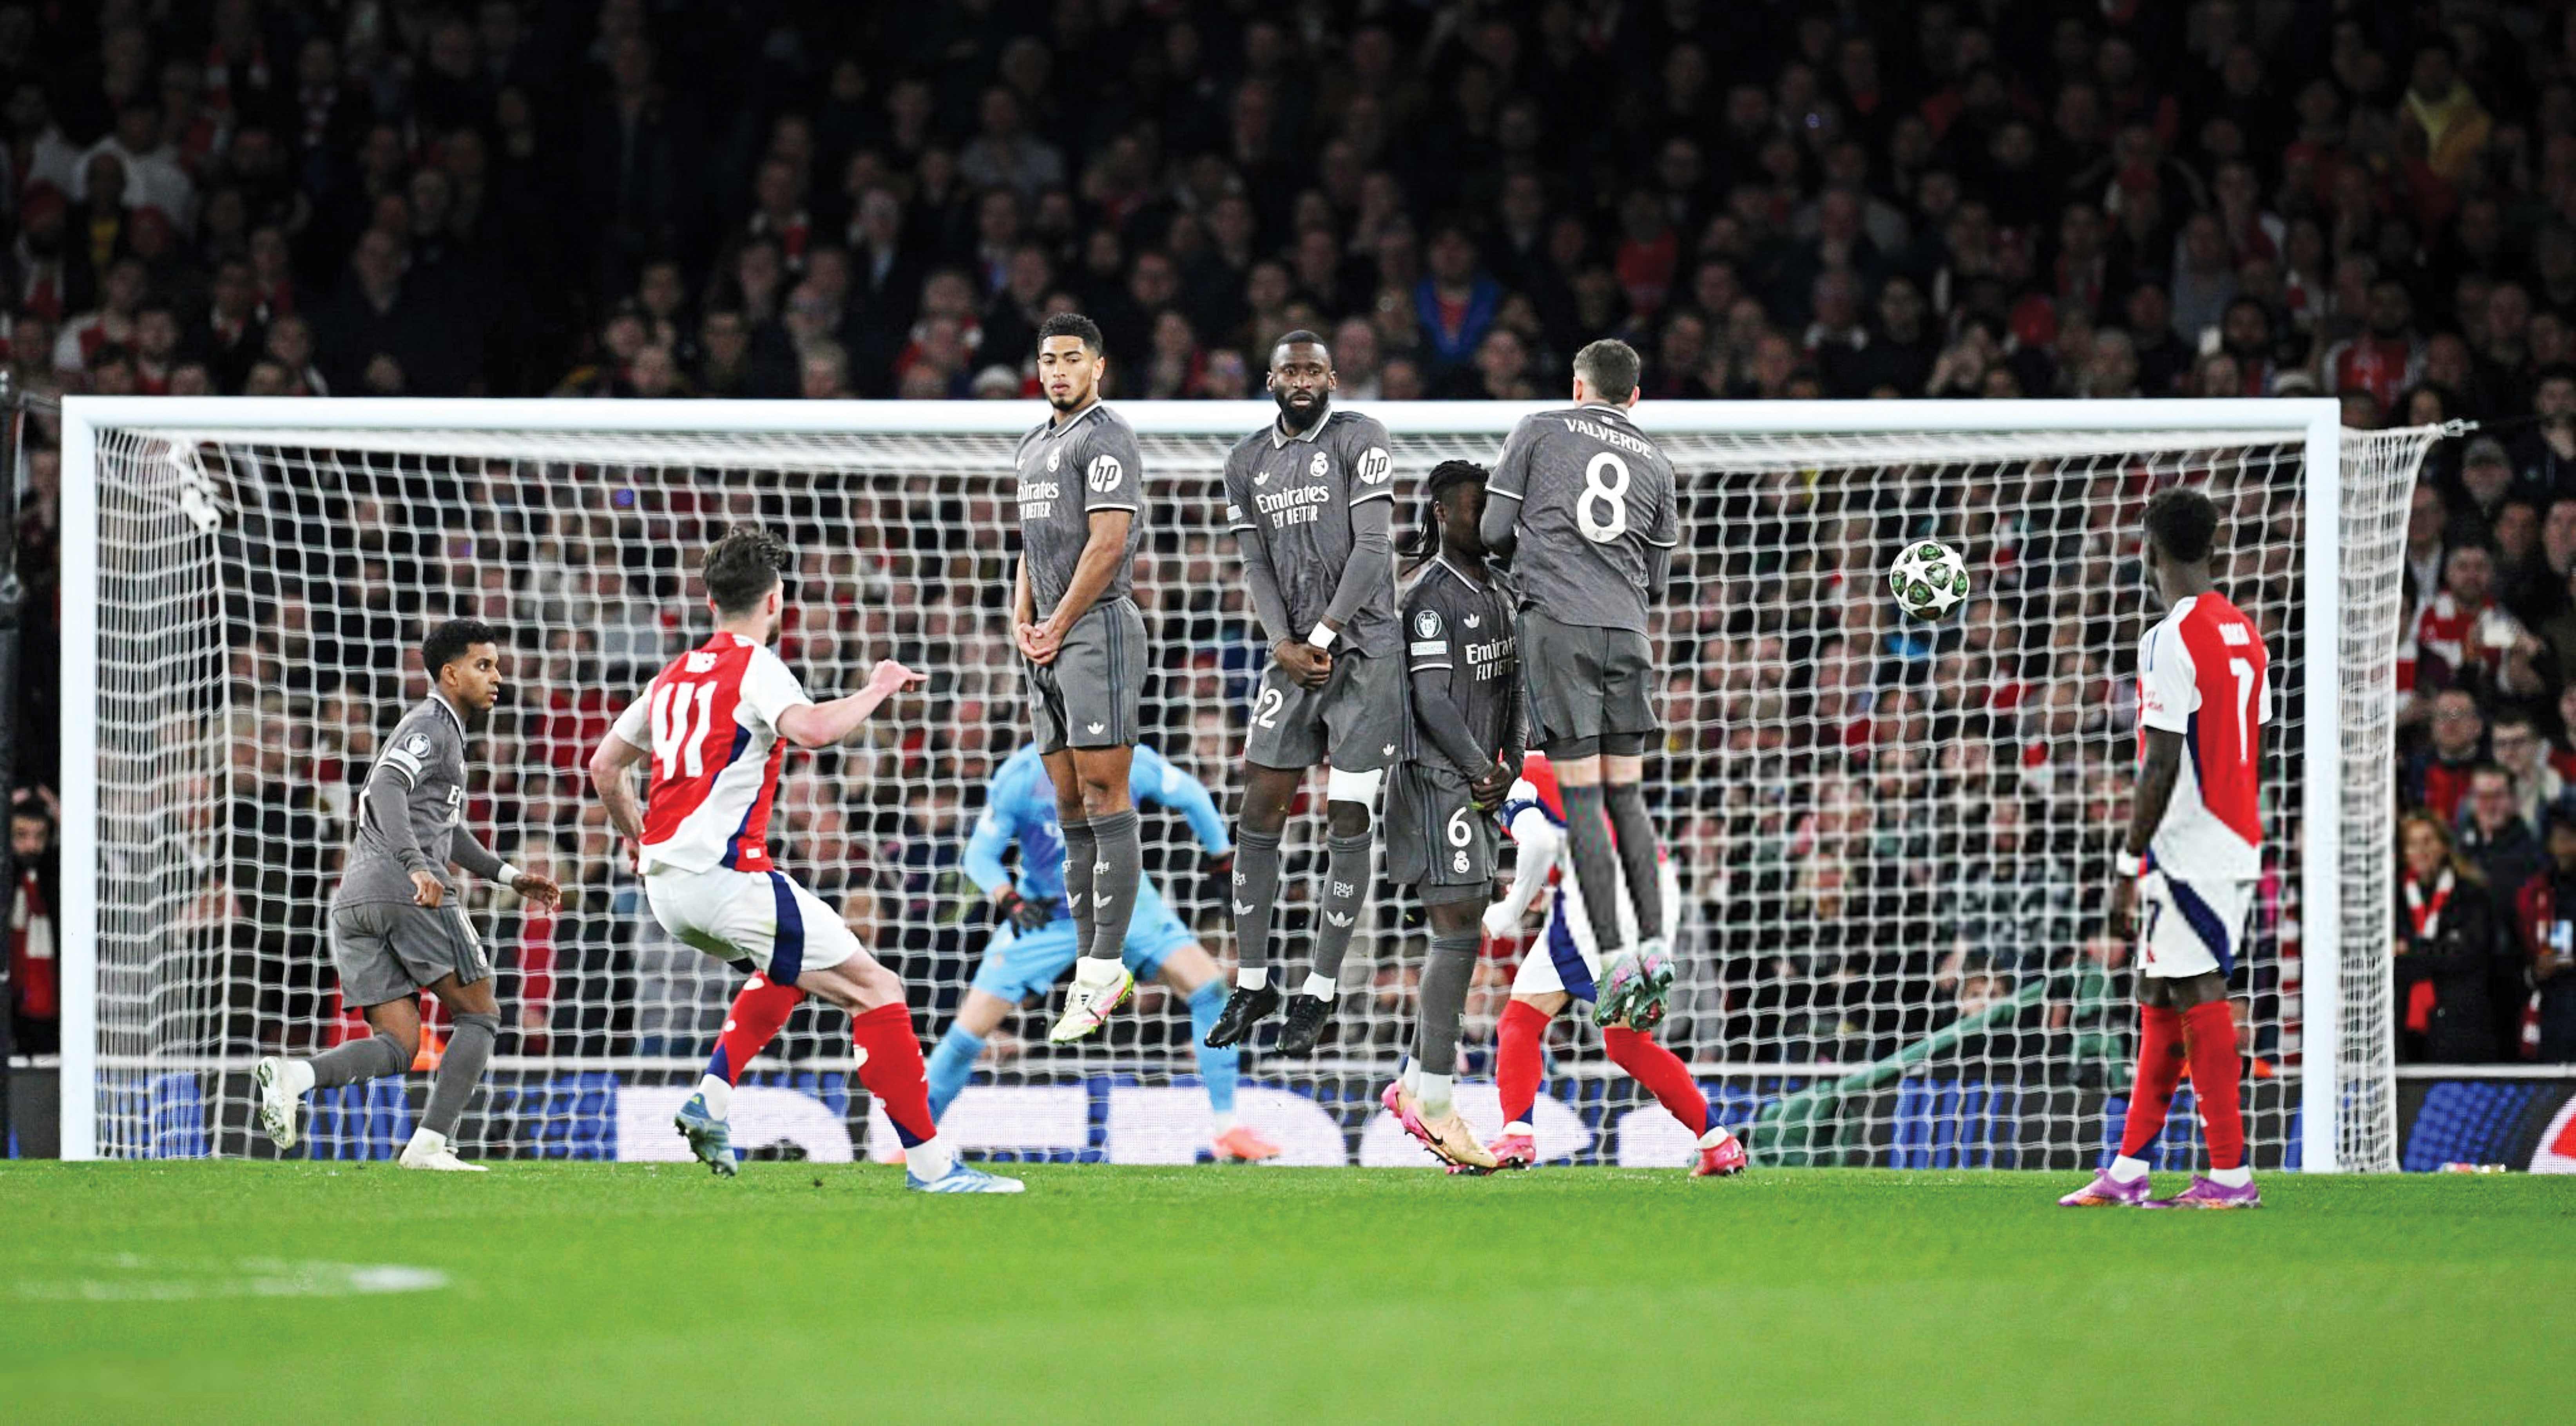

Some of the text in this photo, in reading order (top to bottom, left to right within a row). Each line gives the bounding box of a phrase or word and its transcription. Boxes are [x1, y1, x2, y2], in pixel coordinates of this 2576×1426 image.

[1563, 418, 1652, 459] VALVERDE
[1091, 455, 1117, 493] hp
[1363, 447, 1388, 484] hp
[1255, 485, 1330, 513] Emirates
[1577, 452, 1629, 543] 8
[1465, 635, 1516, 664] Emirat
[1476, 663, 1493, 681] FLY
[651, 681, 717, 780] 41
[2229, 658, 2255, 764] 7
[1448, 806, 1472, 847] 6
